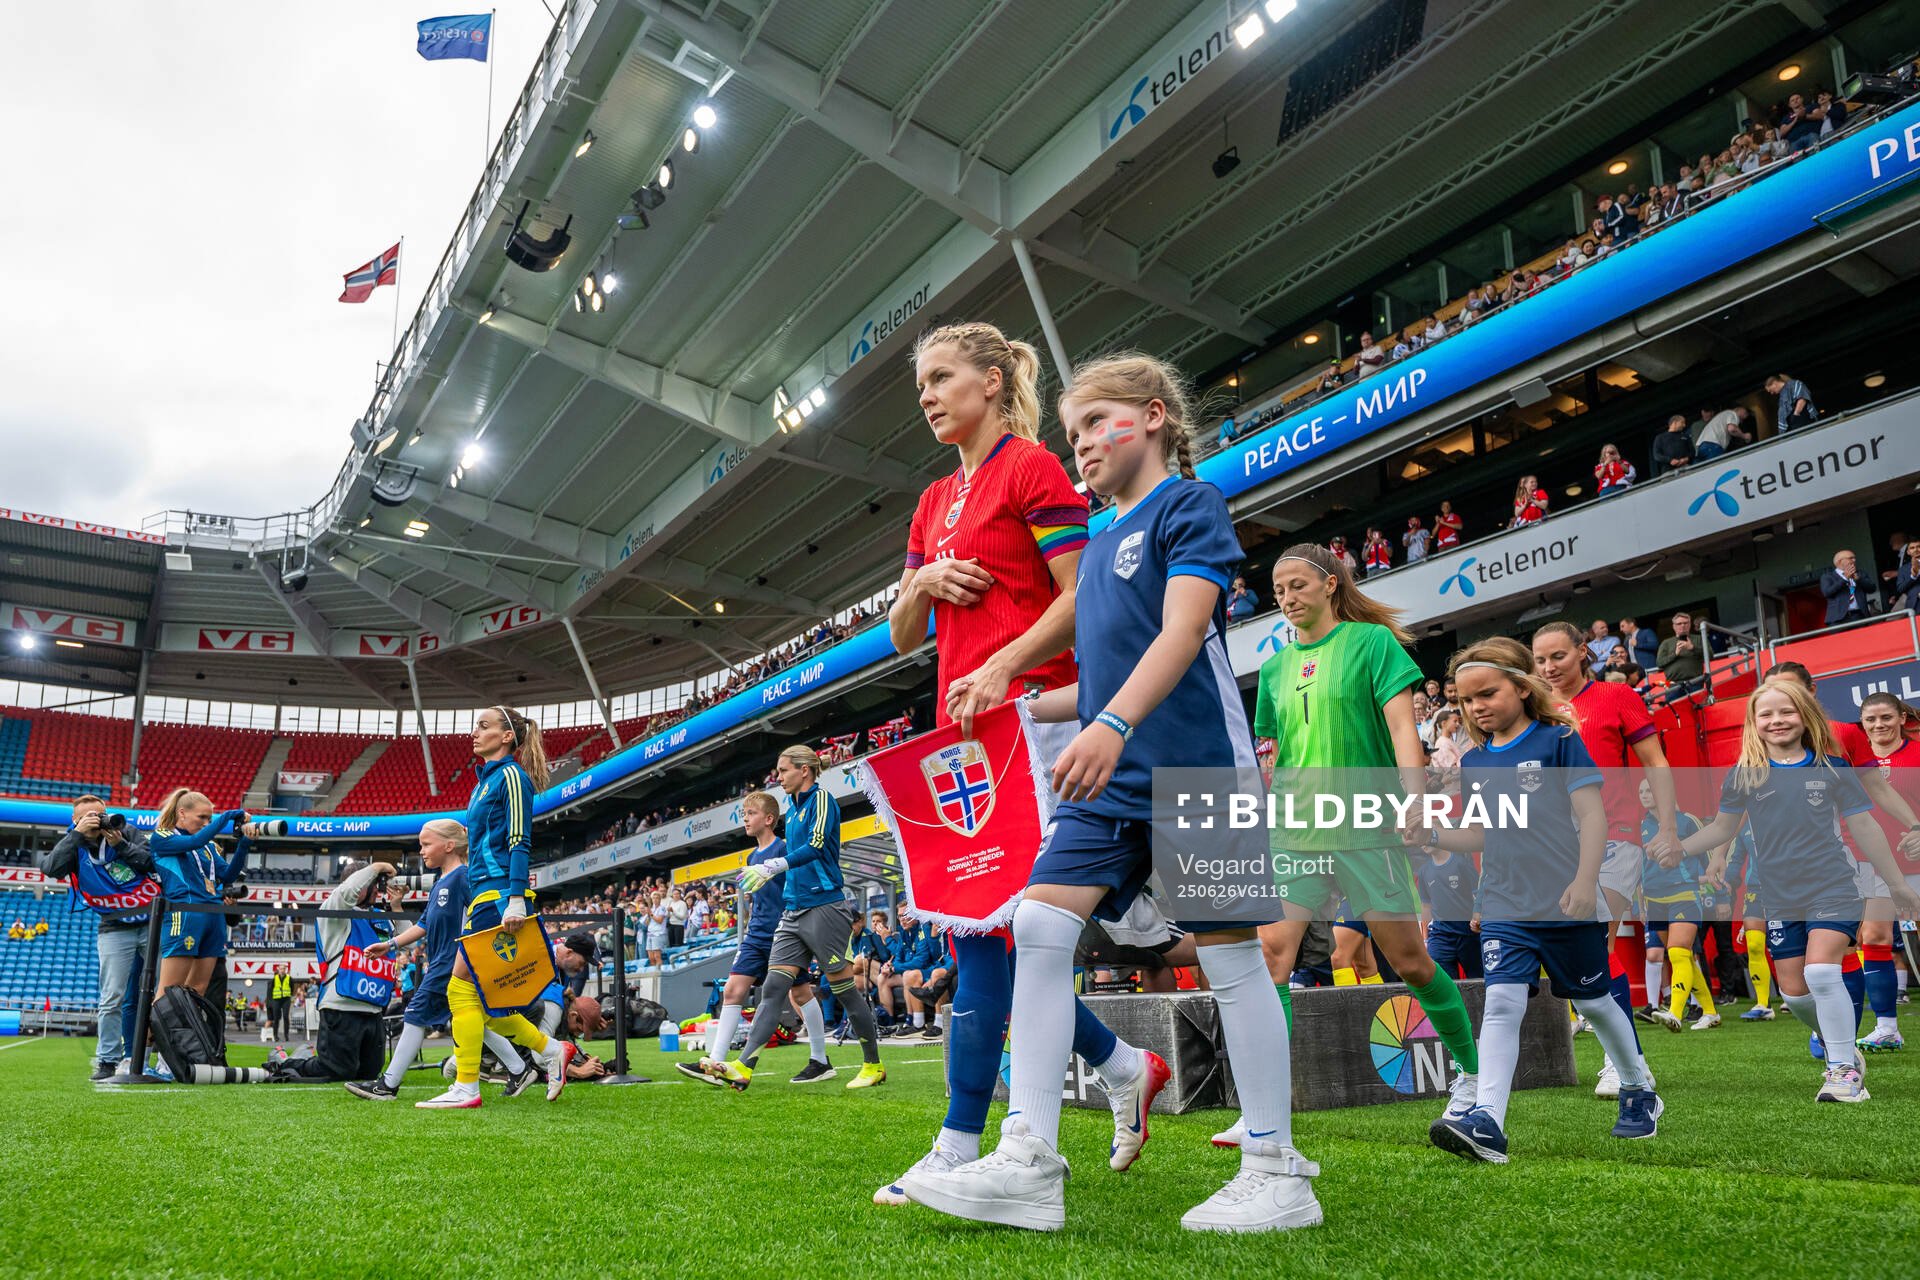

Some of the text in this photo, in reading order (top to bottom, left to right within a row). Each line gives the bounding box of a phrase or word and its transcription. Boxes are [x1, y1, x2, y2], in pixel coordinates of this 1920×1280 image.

[1150, 24, 1235, 106] telen
[873, 283, 930, 344] telenor
[1244, 416, 1326, 477] PEACE
[1356, 368, 1427, 425] МИР
[1739, 434, 1885, 500] telenor
[1476, 534, 1580, 584] telenor
[14, 607, 123, 642] VG
[480, 605, 541, 635] VG
[200, 629, 292, 652] VG
[762, 678, 792, 705] PEACE
[800, 662, 825, 688] МИР
[1302, 692, 1309, 725] 1
[644, 739, 665, 760] PEACE
[940, 746, 962, 760] NORGE
[280, 772, 324, 785] VG
[561, 782, 577, 799] PEACE
[137, 814, 159, 827] МИ
[297, 822, 333, 833] PEACE
[343, 821, 371, 832] МИР
[691, 818, 712, 834] telenor
[947, 859, 973, 873] NORWAY
[978, 850, 1005, 864] SWEDEN
[357, 978, 386, 999] 084
[513, 980, 527, 988] Oslo
